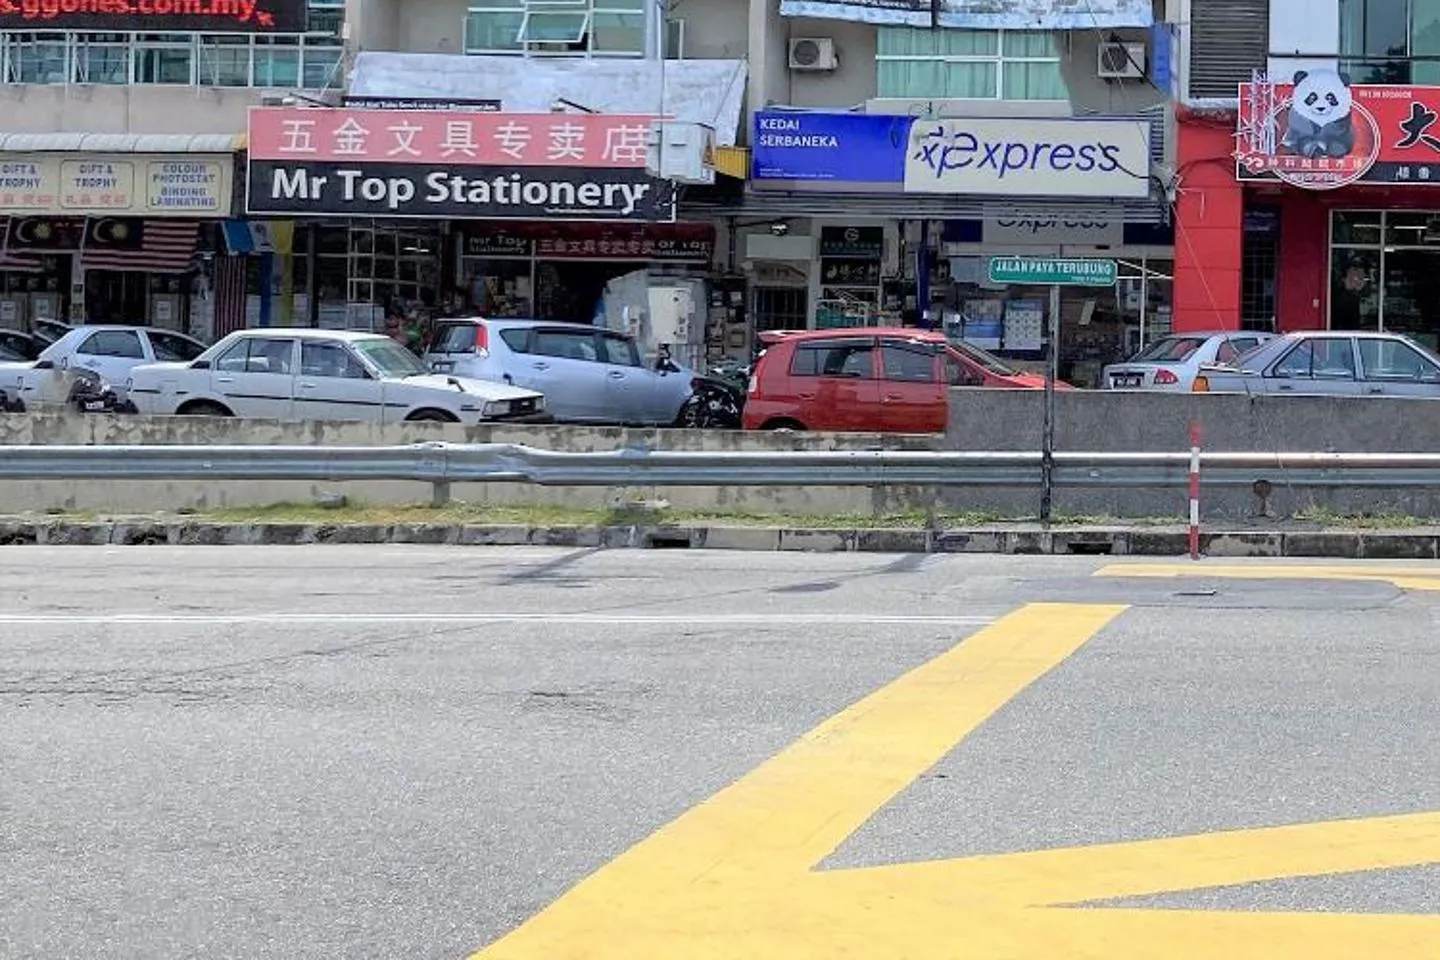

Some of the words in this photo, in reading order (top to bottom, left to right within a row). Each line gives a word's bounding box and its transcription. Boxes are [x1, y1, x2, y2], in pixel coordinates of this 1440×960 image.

[759, 118, 800, 130] KEDAI
[759, 134, 839, 148] SERBANEKA
[162, 164, 207, 174] COLOUR
[75, 177, 118, 189] TROPHY
[152, 174, 215, 183] PHOTOSTAT
[161, 187, 207, 197] BINDING
[271, 169, 327, 202] Mr
[337, 170, 417, 209] Top
[425, 171, 650, 215] Stationery
[151, 196, 216, 207] LAMINATING
[996, 260, 1028, 273] JALAN
[1029, 262, 1055, 273] PAYA
